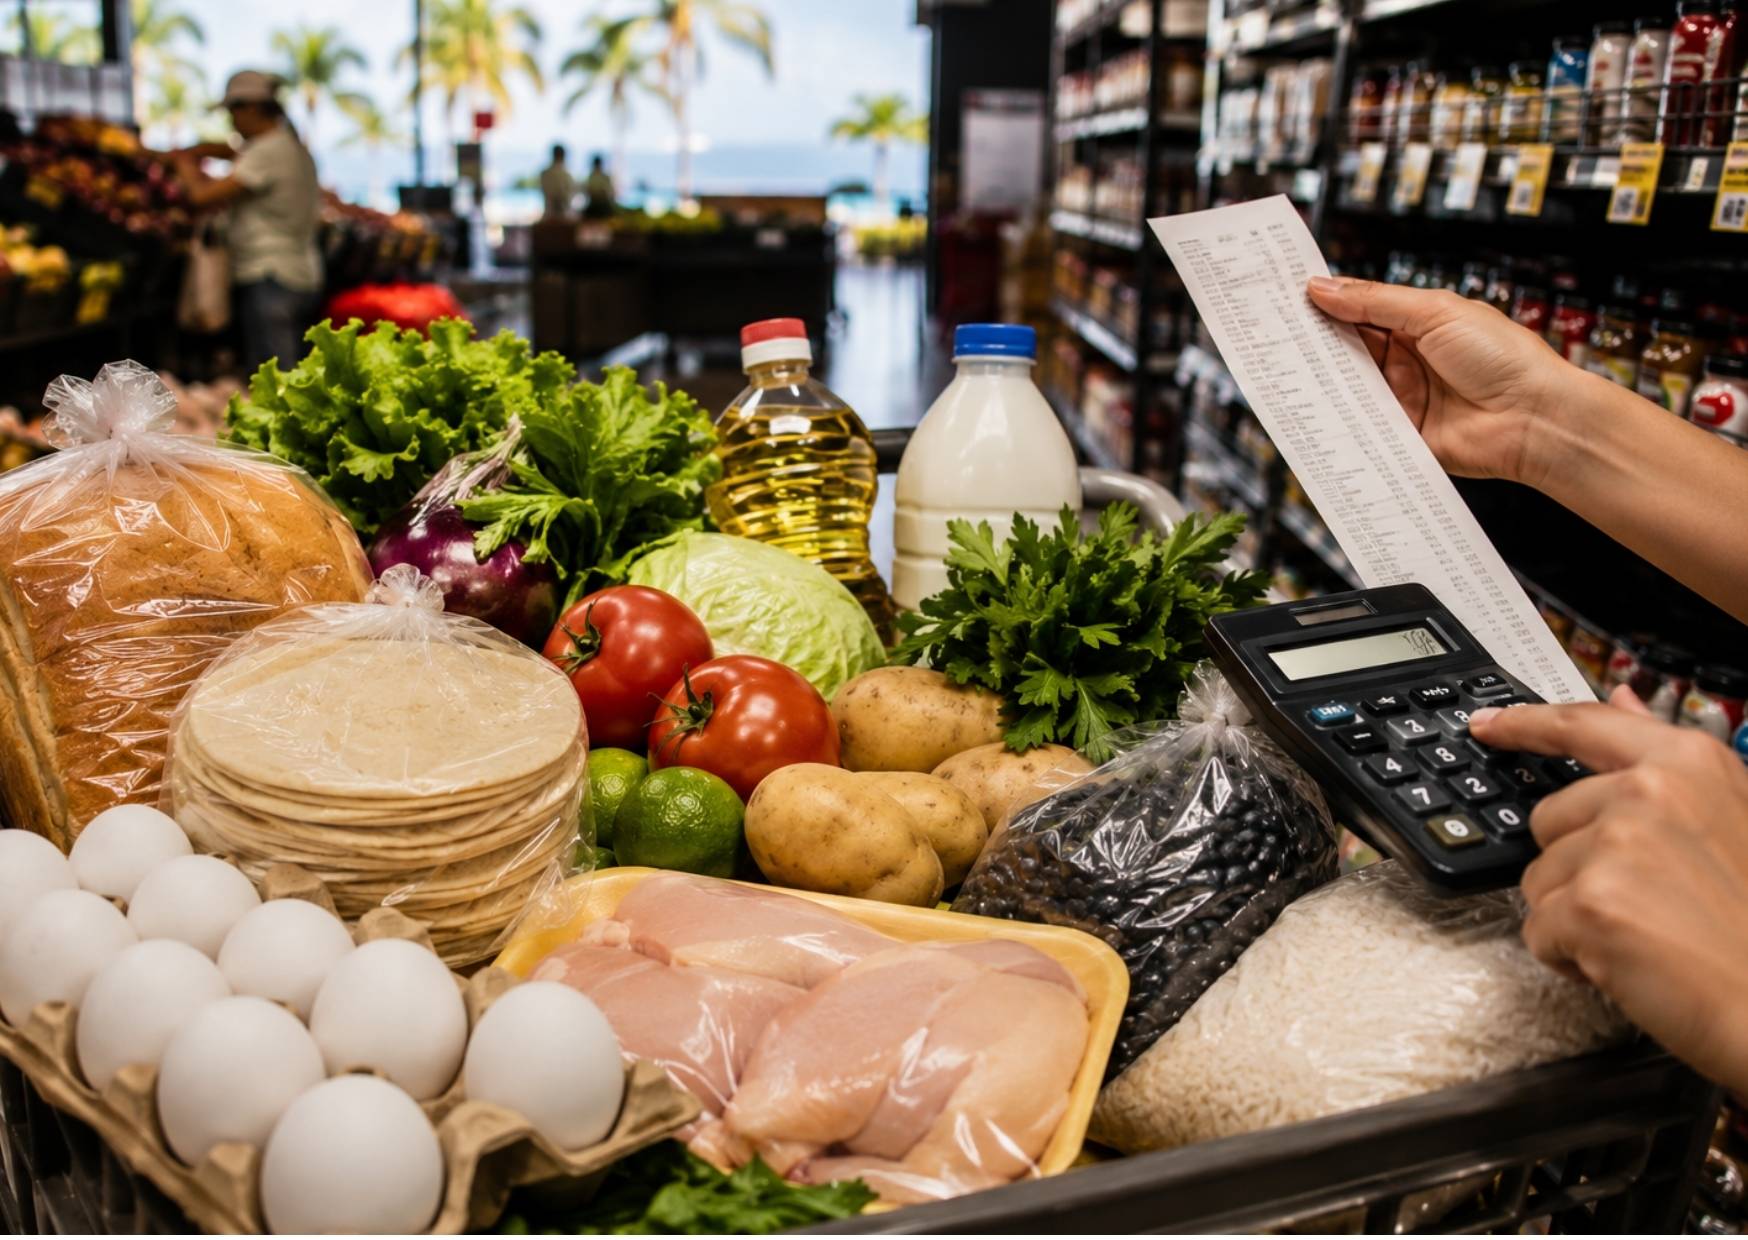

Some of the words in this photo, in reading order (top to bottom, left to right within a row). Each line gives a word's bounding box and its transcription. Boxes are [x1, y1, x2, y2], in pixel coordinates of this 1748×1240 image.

[1435, 747, 1456, 762] 8
[1386, 757, 1402, 773] 4
[1465, 777, 1488, 793] 2
[1411, 787, 1431, 805] 7
[1498, 808, 1520, 825] 0
